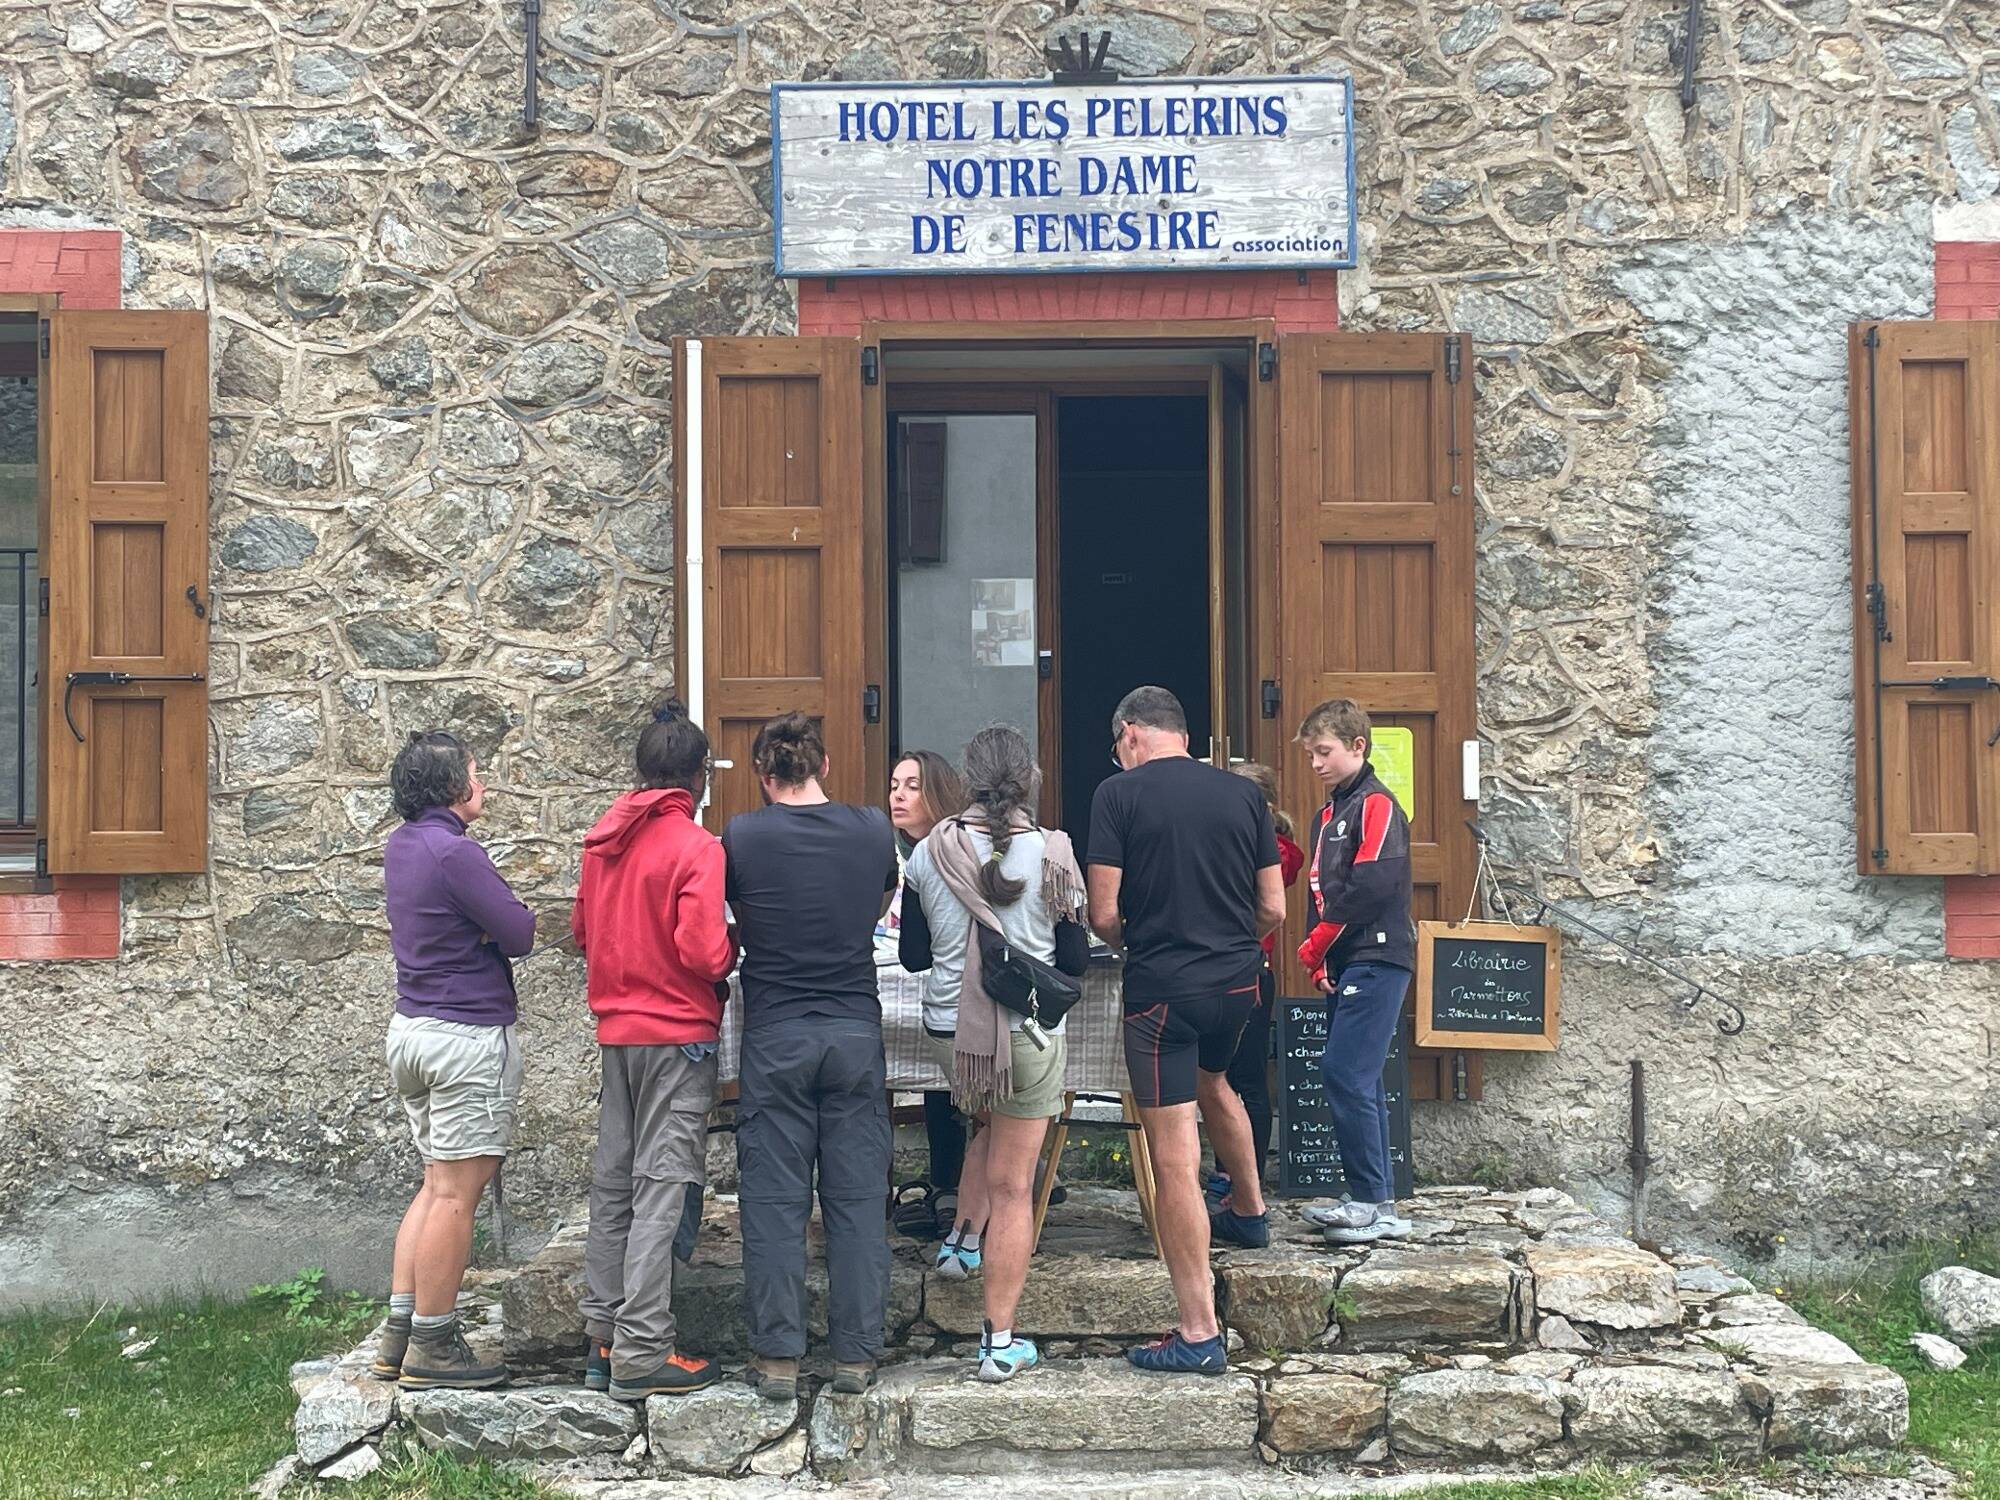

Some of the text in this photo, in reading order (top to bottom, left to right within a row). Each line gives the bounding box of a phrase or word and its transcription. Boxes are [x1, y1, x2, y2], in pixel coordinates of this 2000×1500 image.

[839, 95, 1288, 143] HOTEL LES PELERINS
[927, 155, 1198, 199] NOTRE DAME
[911, 214, 967, 255] DE
[1232, 236, 1343, 252] association
[1451, 950, 1532, 971] Librairie
[1290, 1007, 1328, 1021] Bienve
